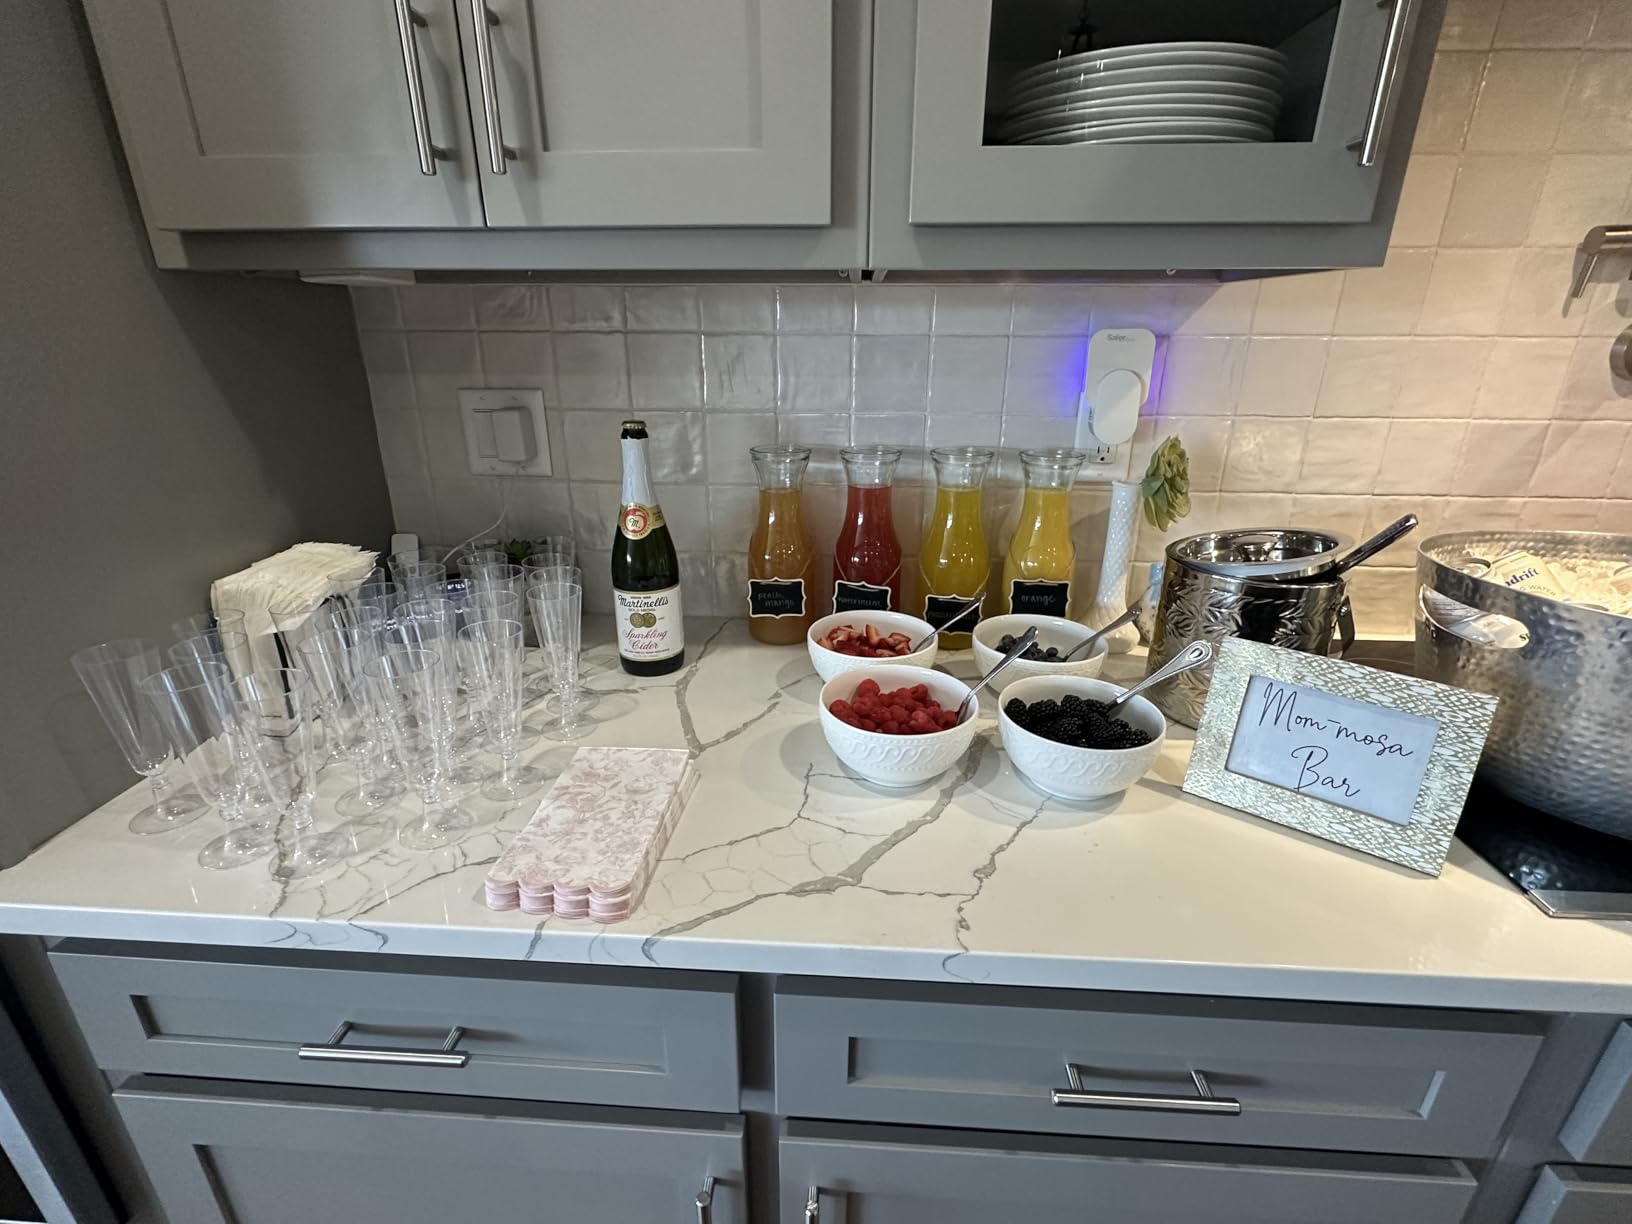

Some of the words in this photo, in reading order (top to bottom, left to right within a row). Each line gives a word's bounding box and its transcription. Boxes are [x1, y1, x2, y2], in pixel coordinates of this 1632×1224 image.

[622, 628, 668, 641] Sparkling
[628, 639, 658, 650] Cider
[1258, 682, 1413, 757] Mom-mosa
[1290, 745, 1361, 798] Bar
